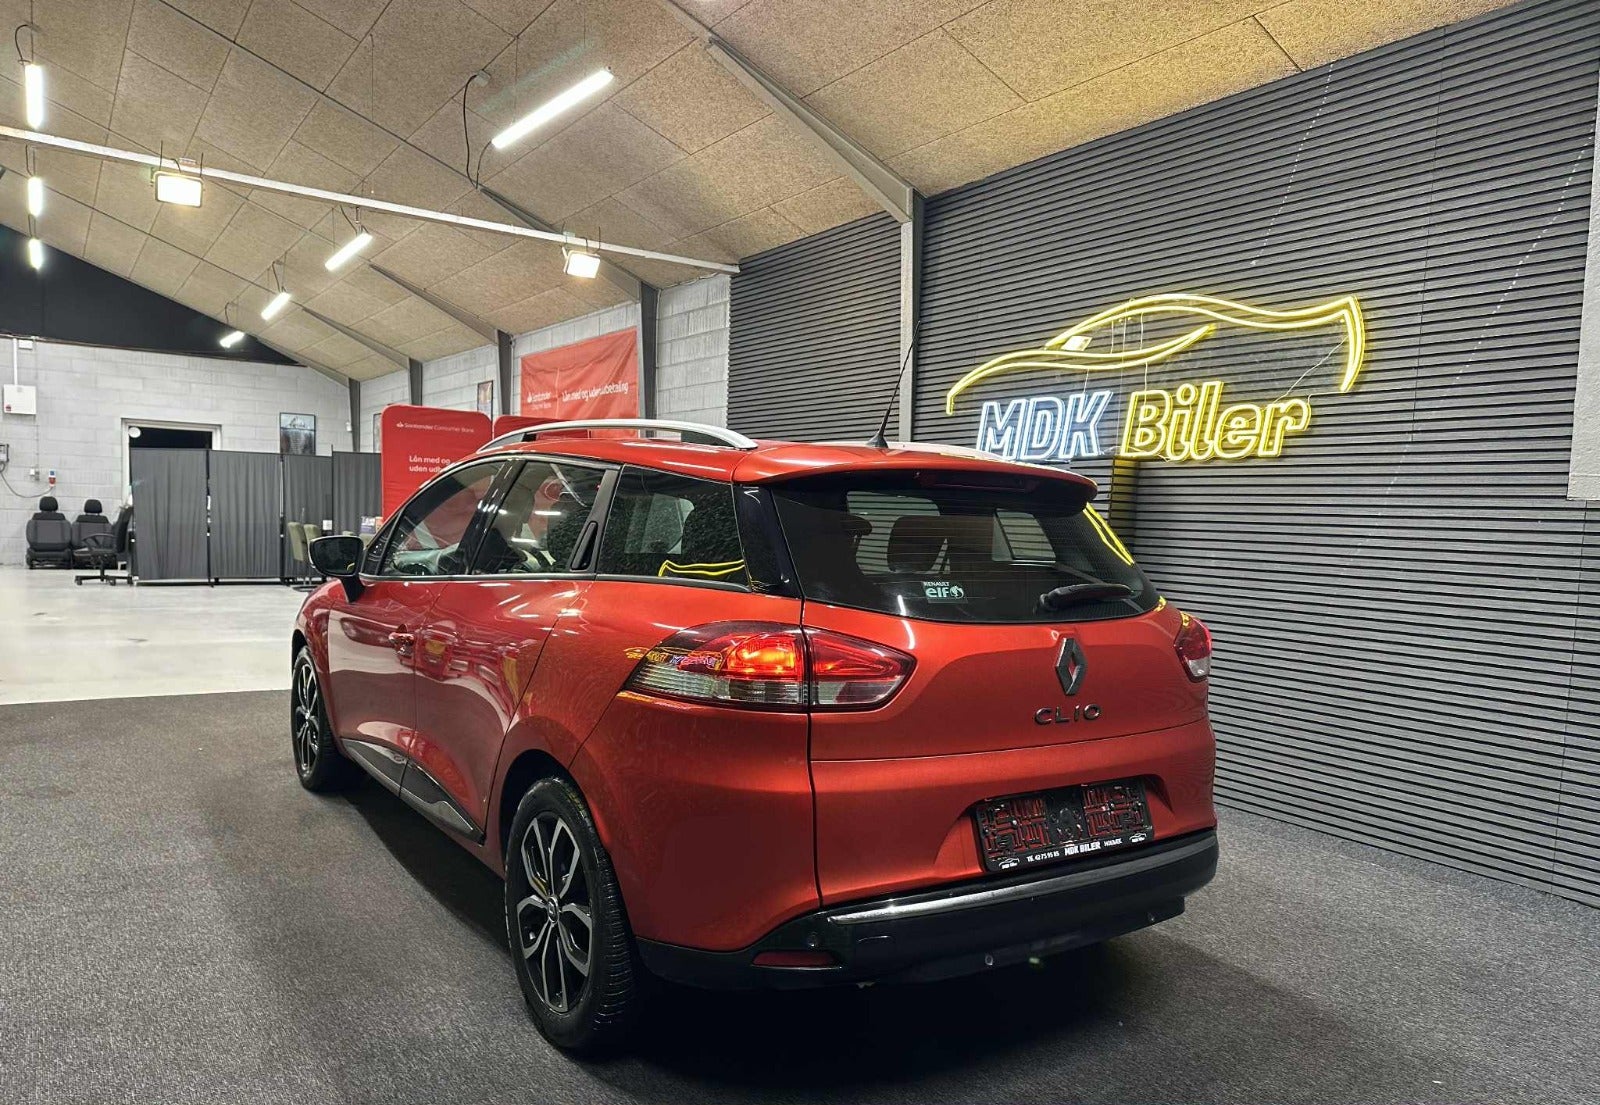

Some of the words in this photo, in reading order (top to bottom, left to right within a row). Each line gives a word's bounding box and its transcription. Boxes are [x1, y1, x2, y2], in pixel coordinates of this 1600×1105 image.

[976, 390, 1113, 460] MDK
[1119, 380, 1310, 462] Biler
[409, 455, 422, 463] Lån
[925, 587, 949, 598] elf
[1064, 846, 1079, 856] MDK
[1080, 841, 1101, 853] BILER
